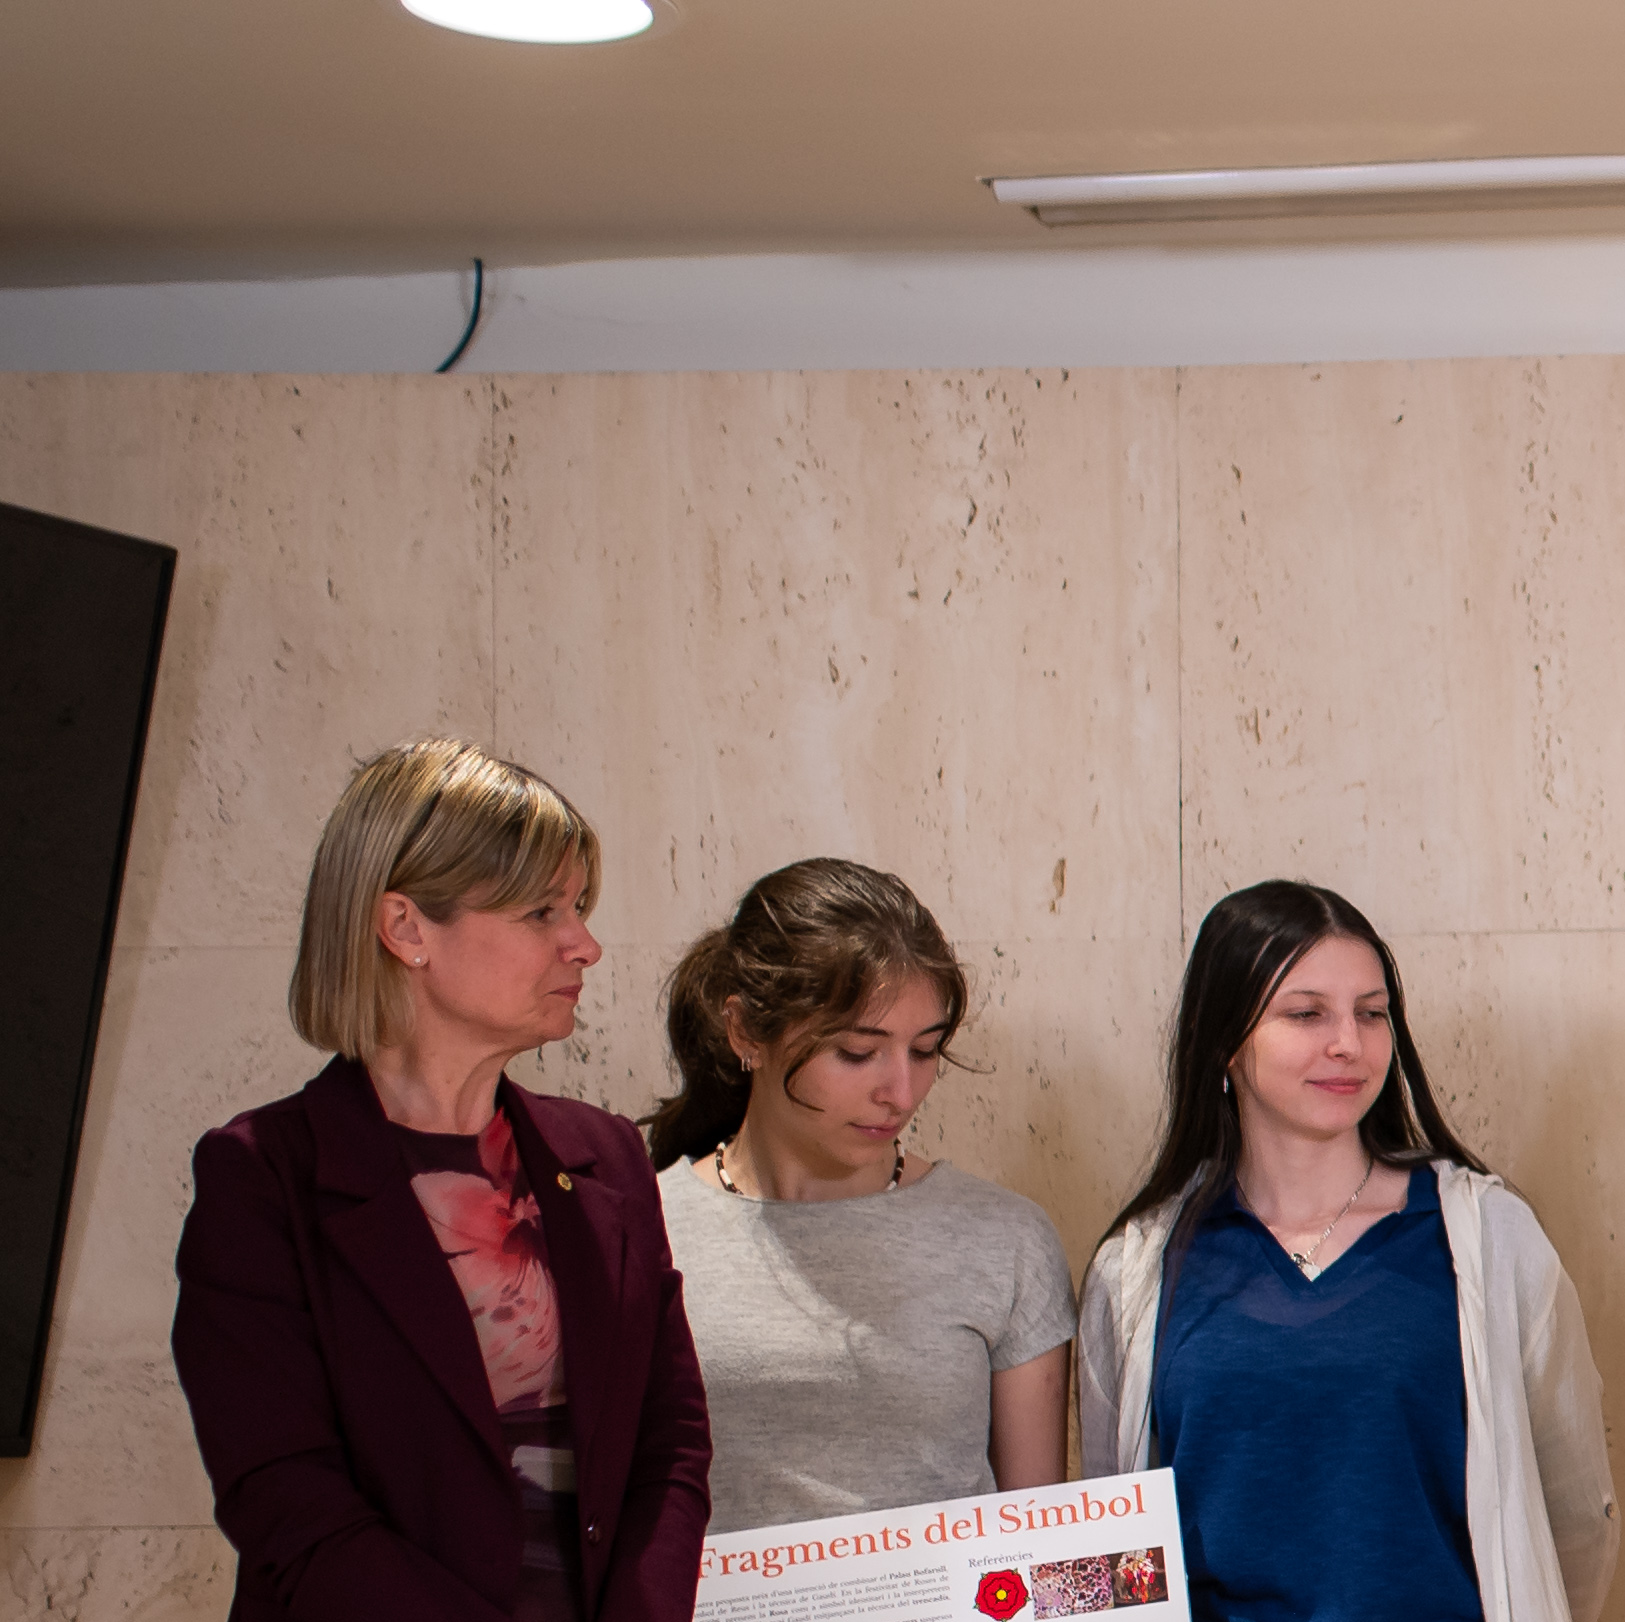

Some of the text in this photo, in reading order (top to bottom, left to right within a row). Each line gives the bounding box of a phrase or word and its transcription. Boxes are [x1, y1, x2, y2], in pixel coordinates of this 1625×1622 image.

[699, 1483, 1147, 1579] Fragments del Símbol
[967, 1550, 1035, 1569] Referències
